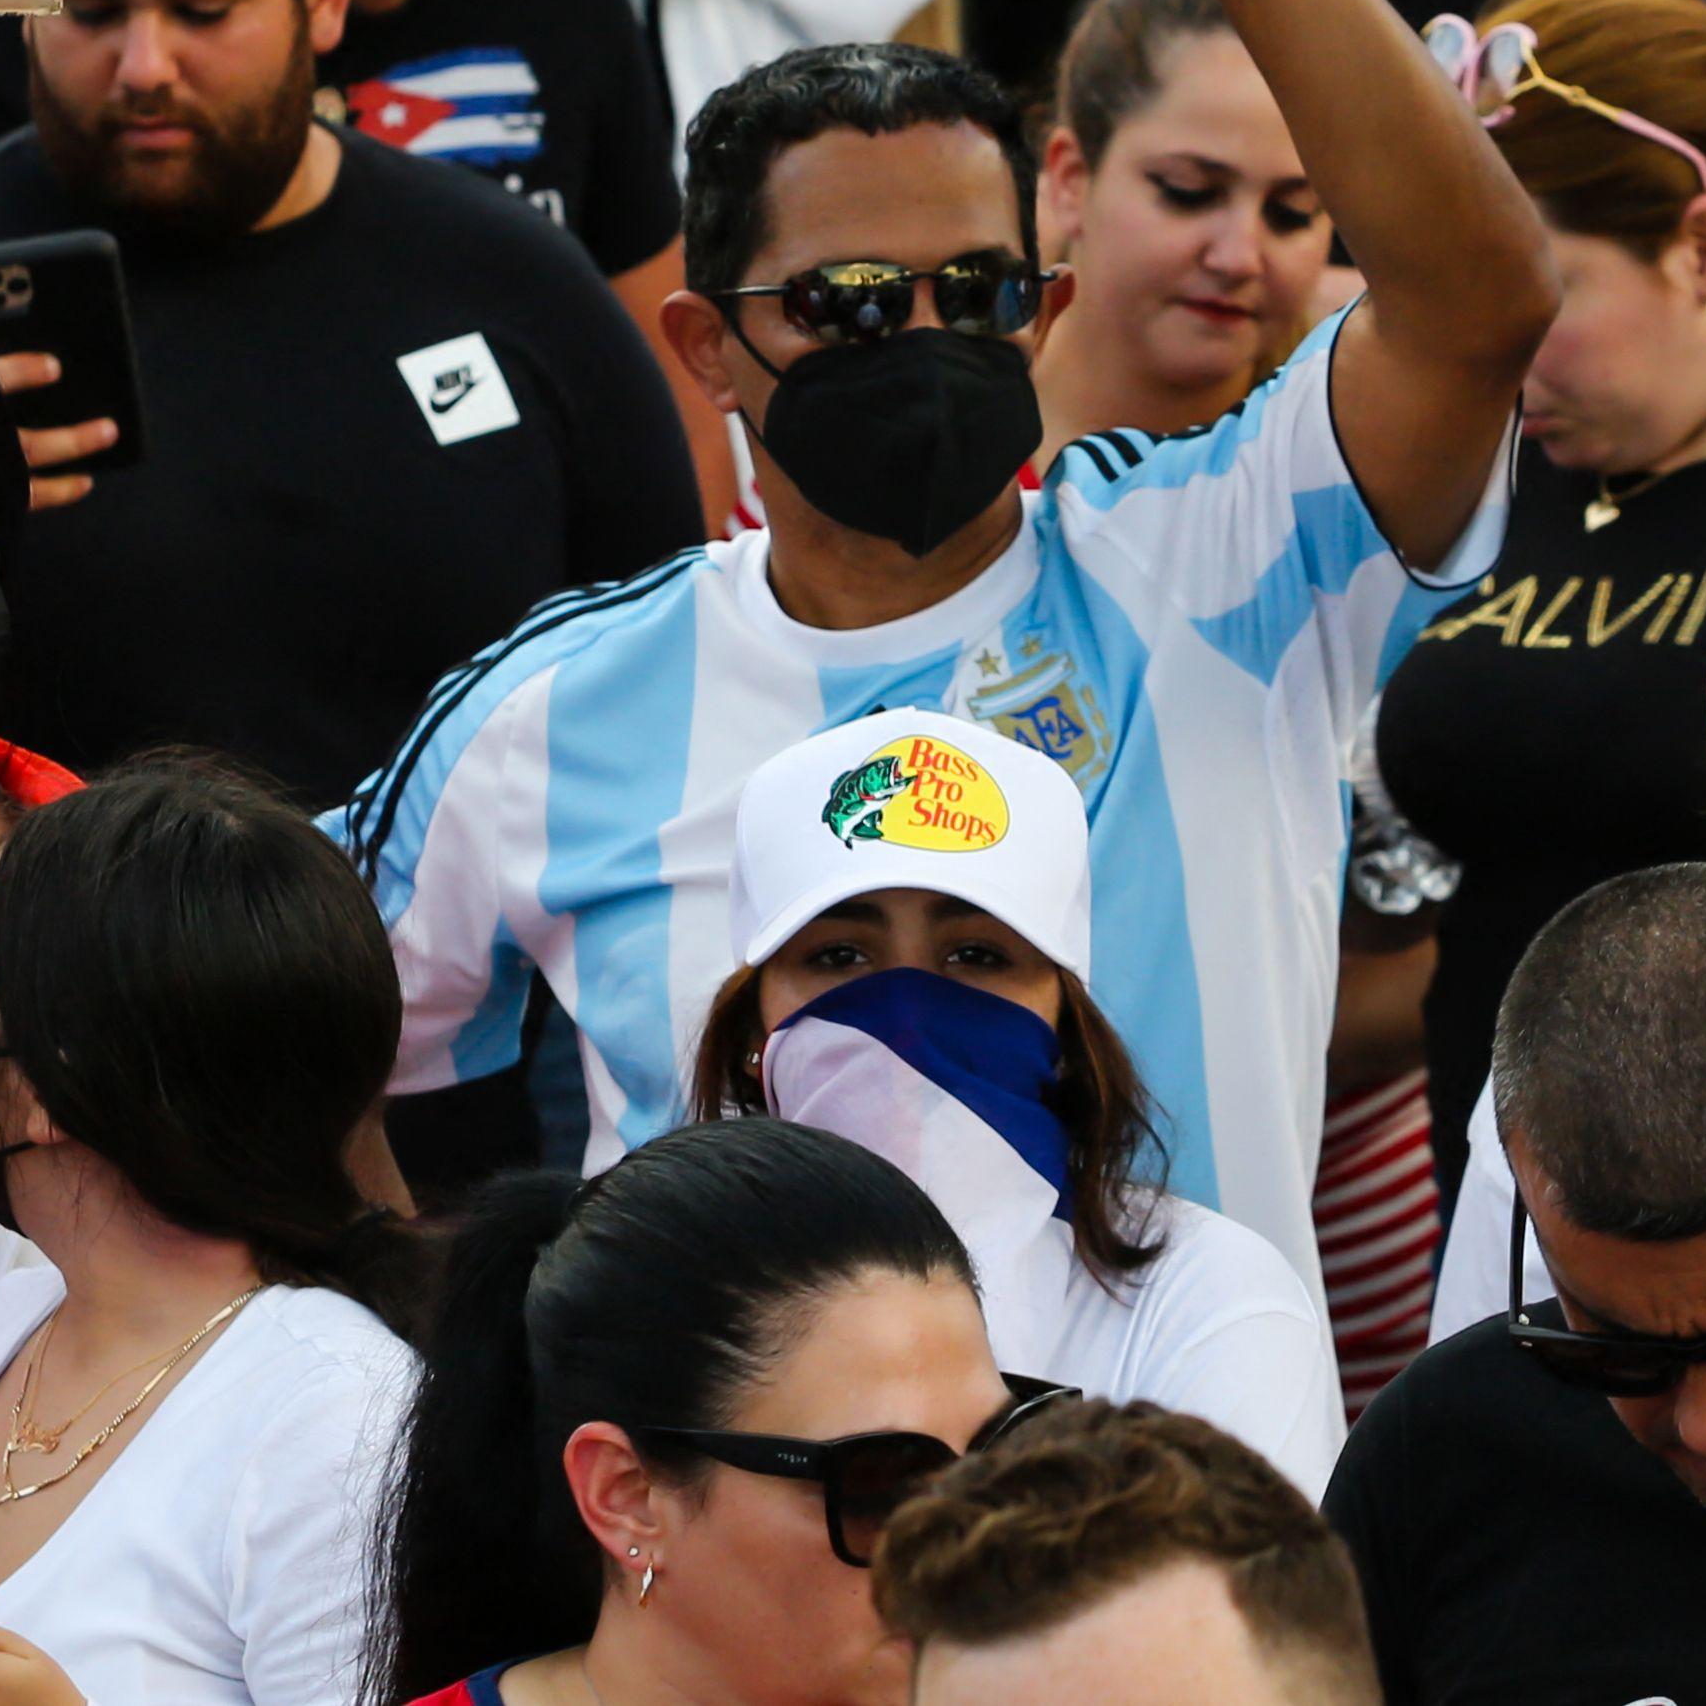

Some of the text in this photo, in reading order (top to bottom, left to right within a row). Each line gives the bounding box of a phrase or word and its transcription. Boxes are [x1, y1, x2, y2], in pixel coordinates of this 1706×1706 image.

[906, 738, 980, 782] Bass
[910, 769, 964, 803] Pro
[907, 797, 997, 844] Shops
